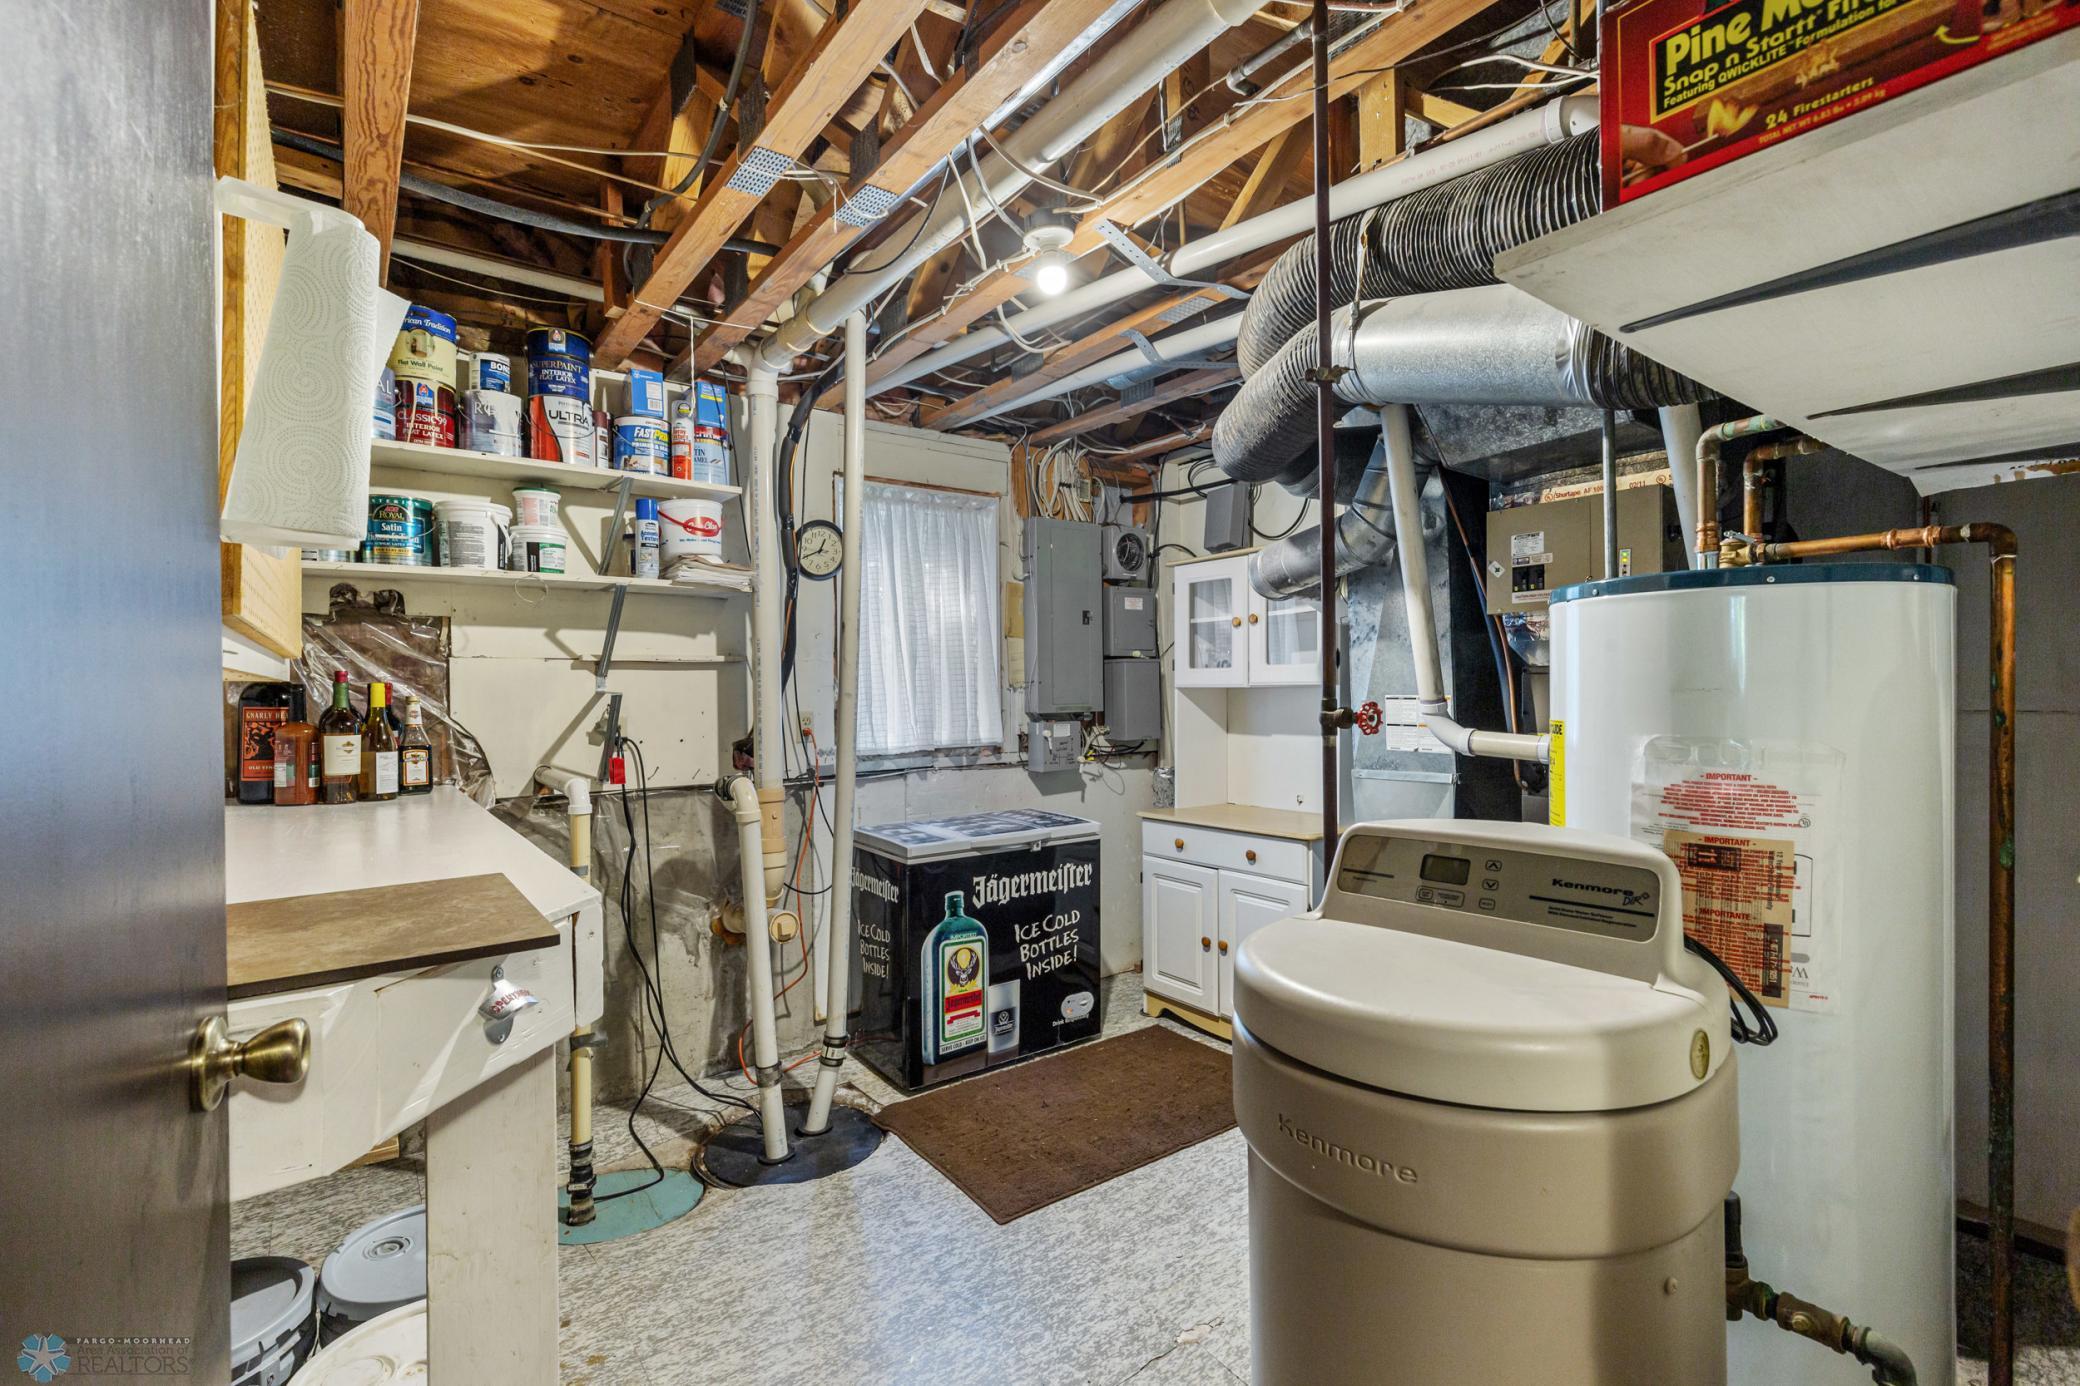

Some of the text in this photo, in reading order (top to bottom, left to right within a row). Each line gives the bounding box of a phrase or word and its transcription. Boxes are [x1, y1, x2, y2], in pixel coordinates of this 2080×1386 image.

[1666, 12, 1752, 76] Pine
[1663, 78, 1716, 109] Featuring
[1717, 44, 1788, 84] QWICKLITE
[1794, 6, 1876, 49] Formulation
[1664, 62, 1719, 97] Snap
[1724, 52, 1740, 68] n
[1765, 76, 1875, 131] 24 Firestarters
[424, 319, 451, 335] Tradition
[549, 409, 590, 428] ULTRA
[1555, 490, 1581, 499] Shurtape
[380, 511, 405, 520] ROYAL
[381, 522, 402, 531] Satin
[1705, 772, 1752, 782] IMPORTANT
[1704, 836, 1750, 847] IMPORTANT
[1552, 878, 1634, 898] Kenmore
[1699, 908, 1753, 921] IMPORTANTE
[857, 920, 890, 943] ICE COLD
[1015, 910, 1080, 943] ICE COLD
[860, 939, 890, 961] BOTTLES
[1020, 928, 1079, 962] BOTTLES
[863, 957, 889, 979] INSIDE!
[1026, 944, 1078, 980] INSIDE!
[1278, 1112, 1418, 1185] Kenmore
